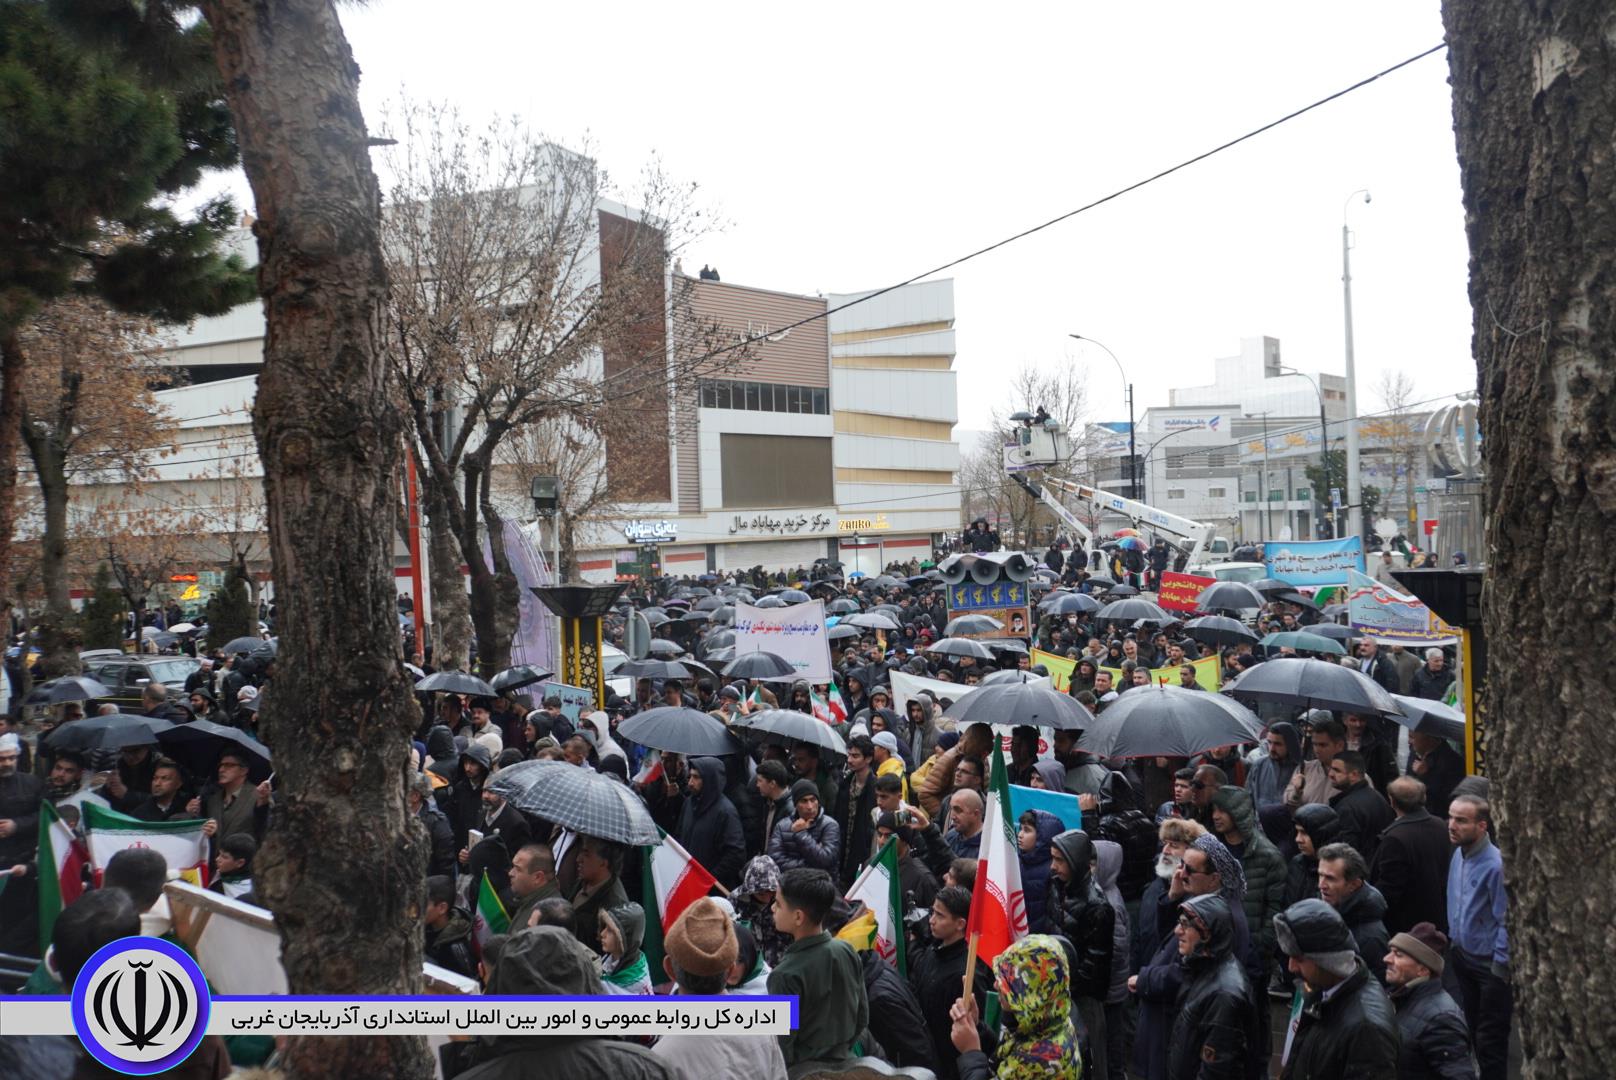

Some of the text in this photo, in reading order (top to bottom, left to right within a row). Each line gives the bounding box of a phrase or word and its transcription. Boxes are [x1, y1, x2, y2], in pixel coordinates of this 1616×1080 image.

[1112, 499, 1123, 509] CTE
[728, 513, 831, 535] مرکز خرید مهاباد مال
[1162, 581, 1196, 589] دانشجویی
[1161, 592, 1180, 601] مهاباد
